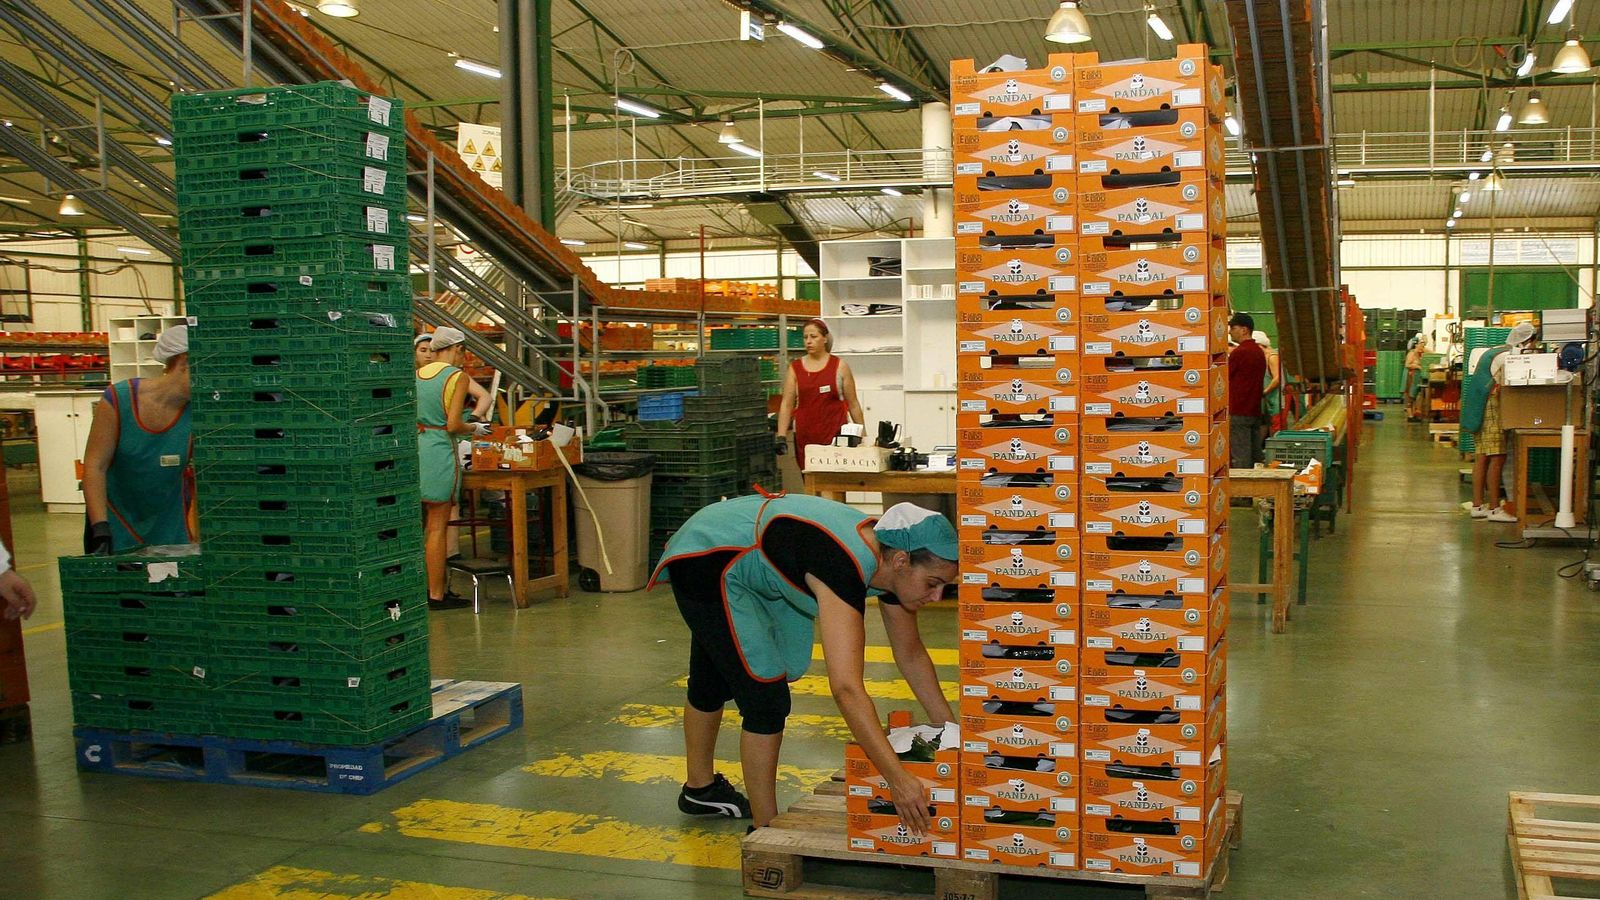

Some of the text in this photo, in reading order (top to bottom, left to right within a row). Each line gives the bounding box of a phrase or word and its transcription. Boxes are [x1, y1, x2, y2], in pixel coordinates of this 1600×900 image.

[994, 393, 1041, 401] PANAL
[810, 457, 877, 467] CALABACIN
[995, 568, 1040, 576] PANDAL
[995, 625, 1040, 634] PANDAL
[1121, 632, 1168, 641] PANDAL
